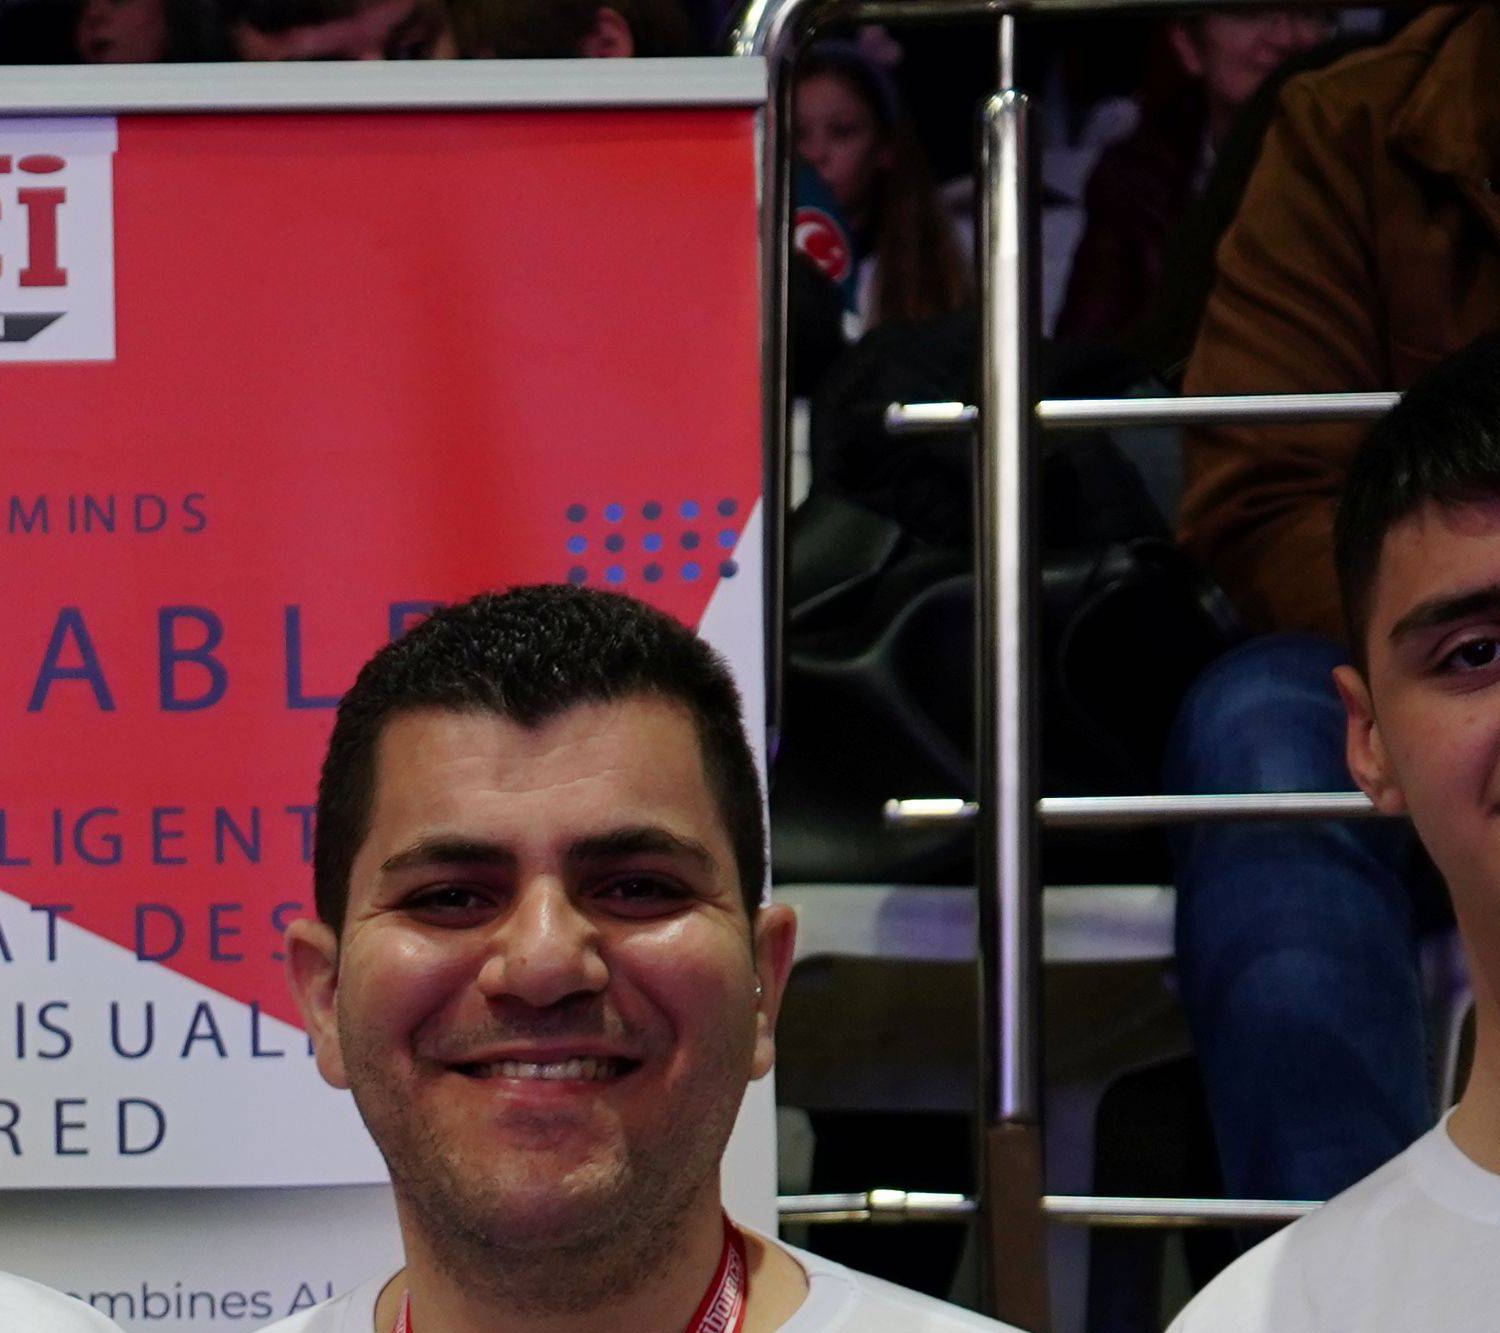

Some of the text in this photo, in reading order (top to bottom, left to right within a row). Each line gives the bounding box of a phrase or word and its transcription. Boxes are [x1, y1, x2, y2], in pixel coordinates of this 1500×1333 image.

[8, 490, 209, 536] MINDS
[133, 901, 300, 963] DES
[63, 1280, 273, 1321] mbines
